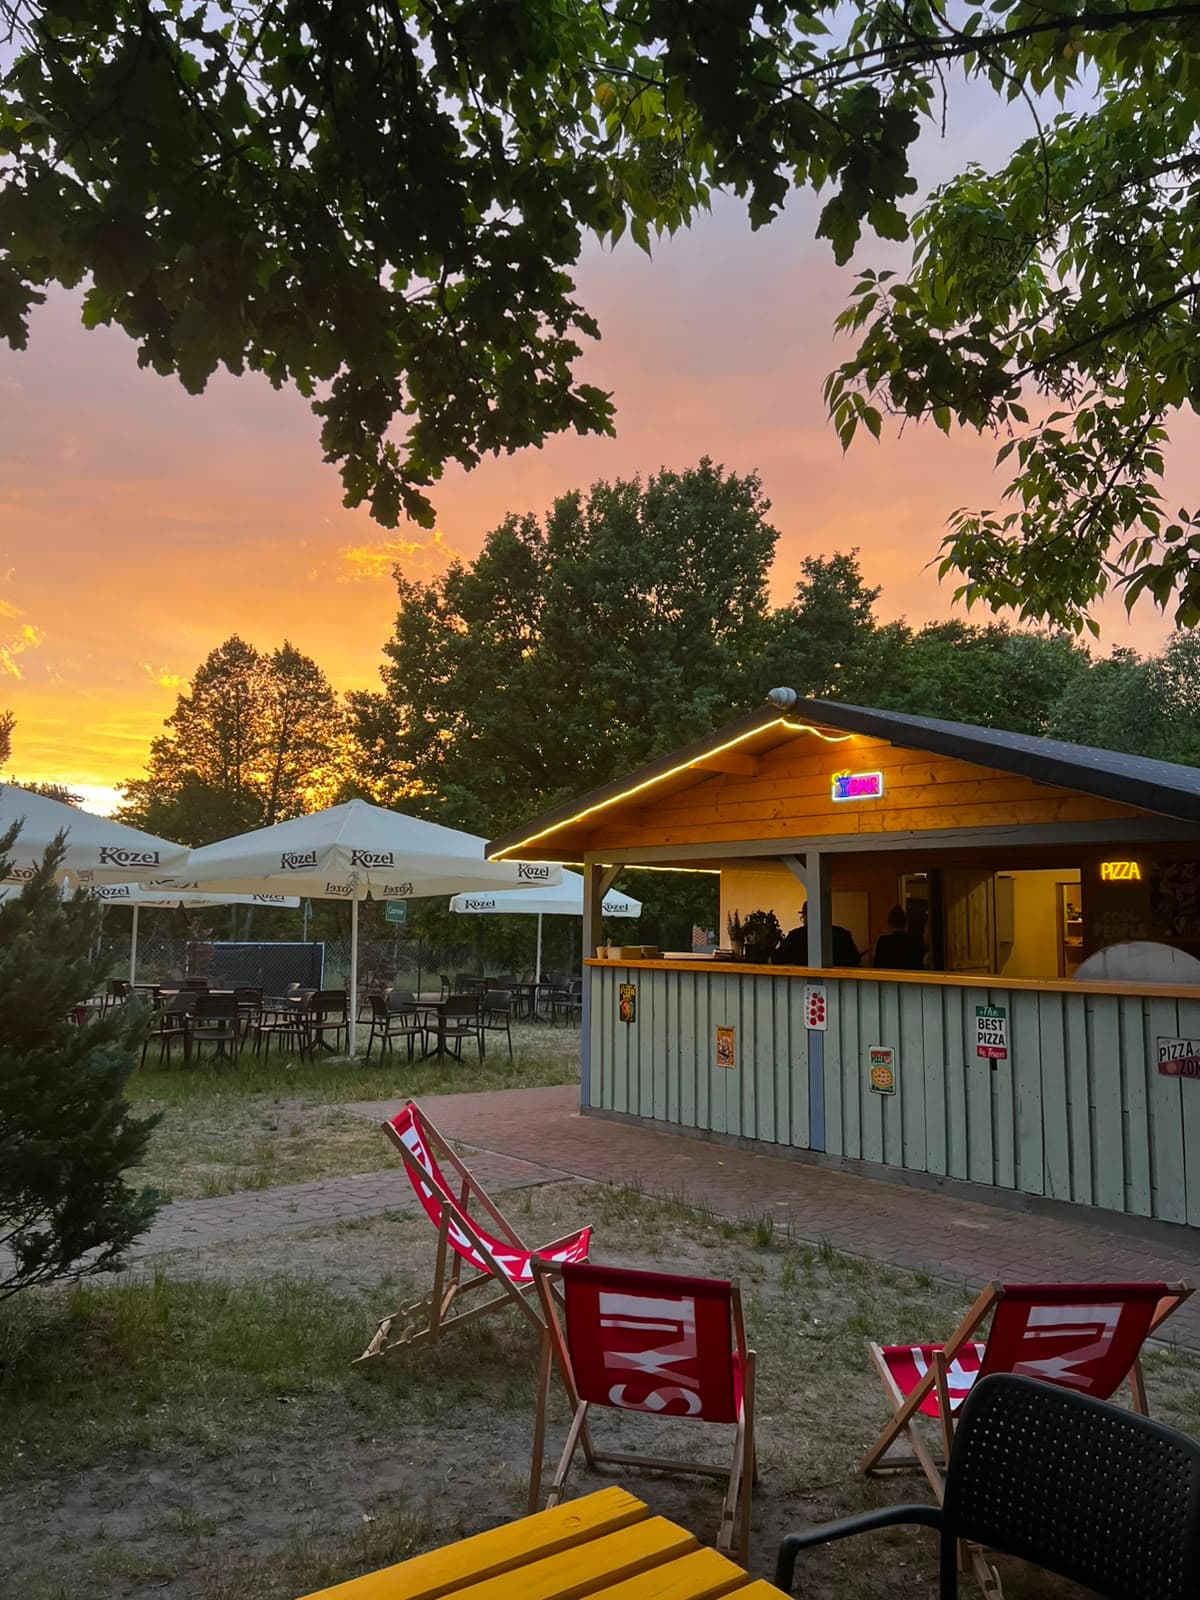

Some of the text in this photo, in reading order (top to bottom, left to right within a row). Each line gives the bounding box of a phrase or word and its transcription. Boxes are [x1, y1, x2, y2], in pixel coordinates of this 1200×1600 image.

[849, 775, 879, 796] BAR
[99, 846, 160, 867] Kozel
[281, 851, 318, 869] Kozel
[351, 849, 395, 868] Kozel
[517, 863, 549, 880] Kozel
[1101, 861, 1141, 880] PIZZA
[90, 885, 130, 899] Kozel
[464, 900, 496, 910] Kozel
[978, 1018, 1004, 1031] BEST
[977, 1031, 1005, 1046] PIZZA
[1159, 1041, 1194, 1062] PIZZA
